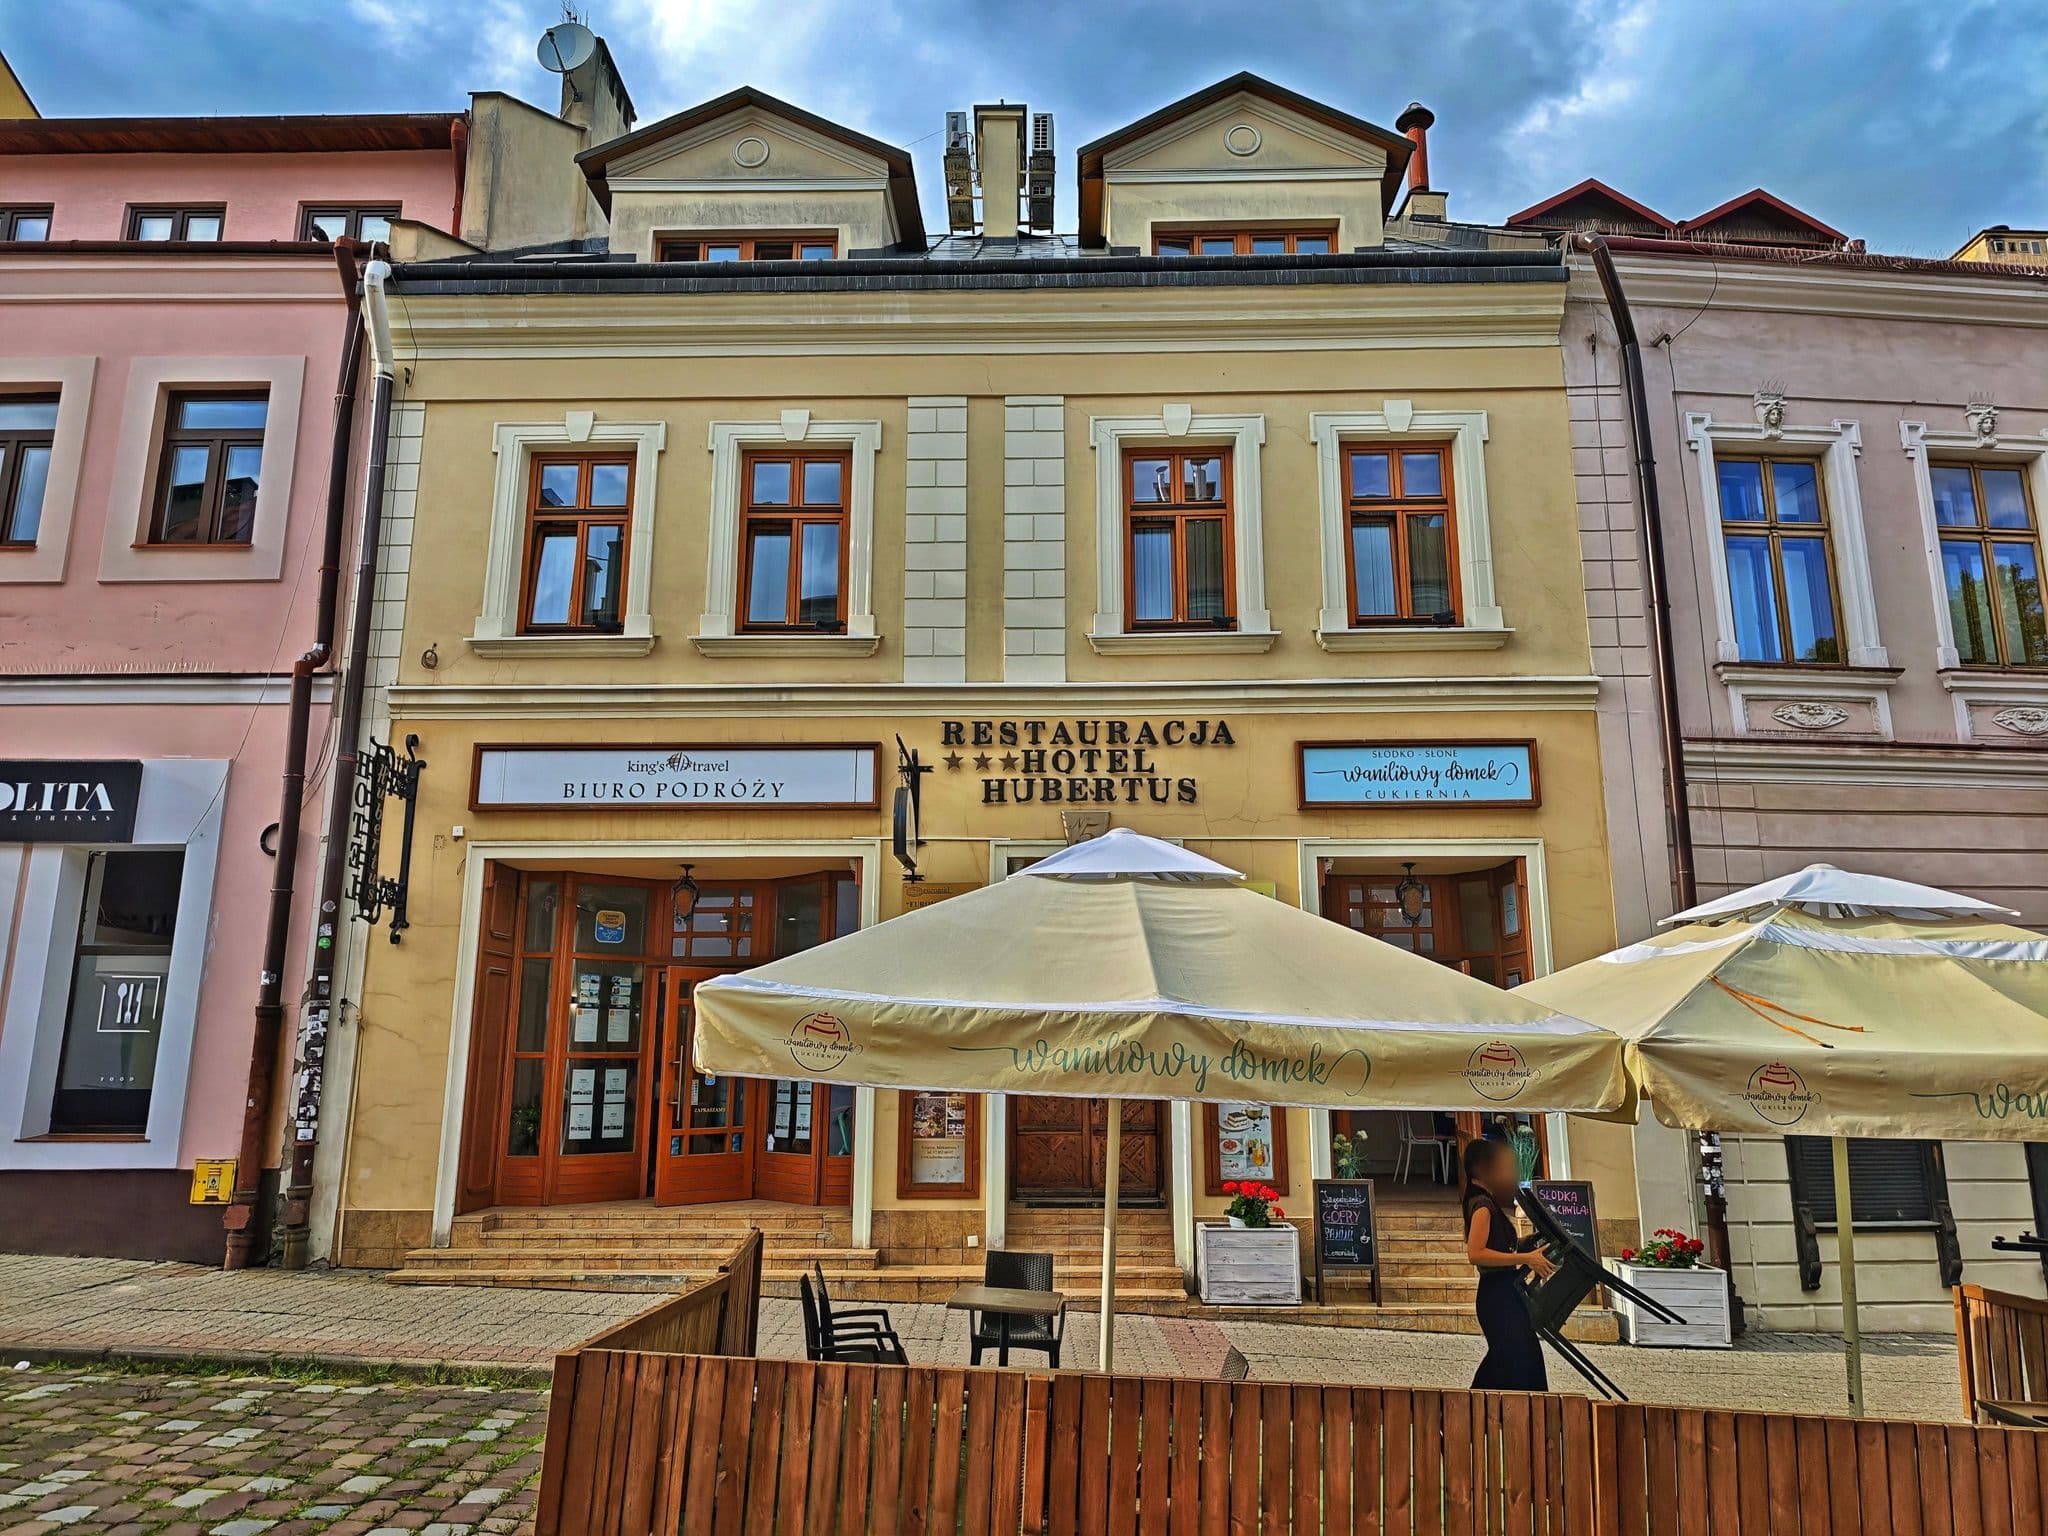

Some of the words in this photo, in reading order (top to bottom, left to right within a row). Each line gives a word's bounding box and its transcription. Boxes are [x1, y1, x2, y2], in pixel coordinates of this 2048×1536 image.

[941, 720, 1236, 746] RESTAURACJA
[627, 760, 665, 775] king's
[692, 760, 729, 773] travel
[1021, 748, 1156, 774] HOTEL
[1312, 760, 1440, 787] waniliowy
[1445, 760, 1519, 785] domek
[563, 782, 646, 799] BIURO
[656, 778, 785, 799] PODRÓŻY
[981, 777, 1198, 803] HUBERTUS
[1365, 789, 1471, 800] CUKIERNIA
[366, 763, 389, 901] Hubertus
[947, 1031, 1215, 1092] waniliowy
[1220, 1039, 1371, 1096] domek
[1322, 1210, 1360, 1224] GOFRY
